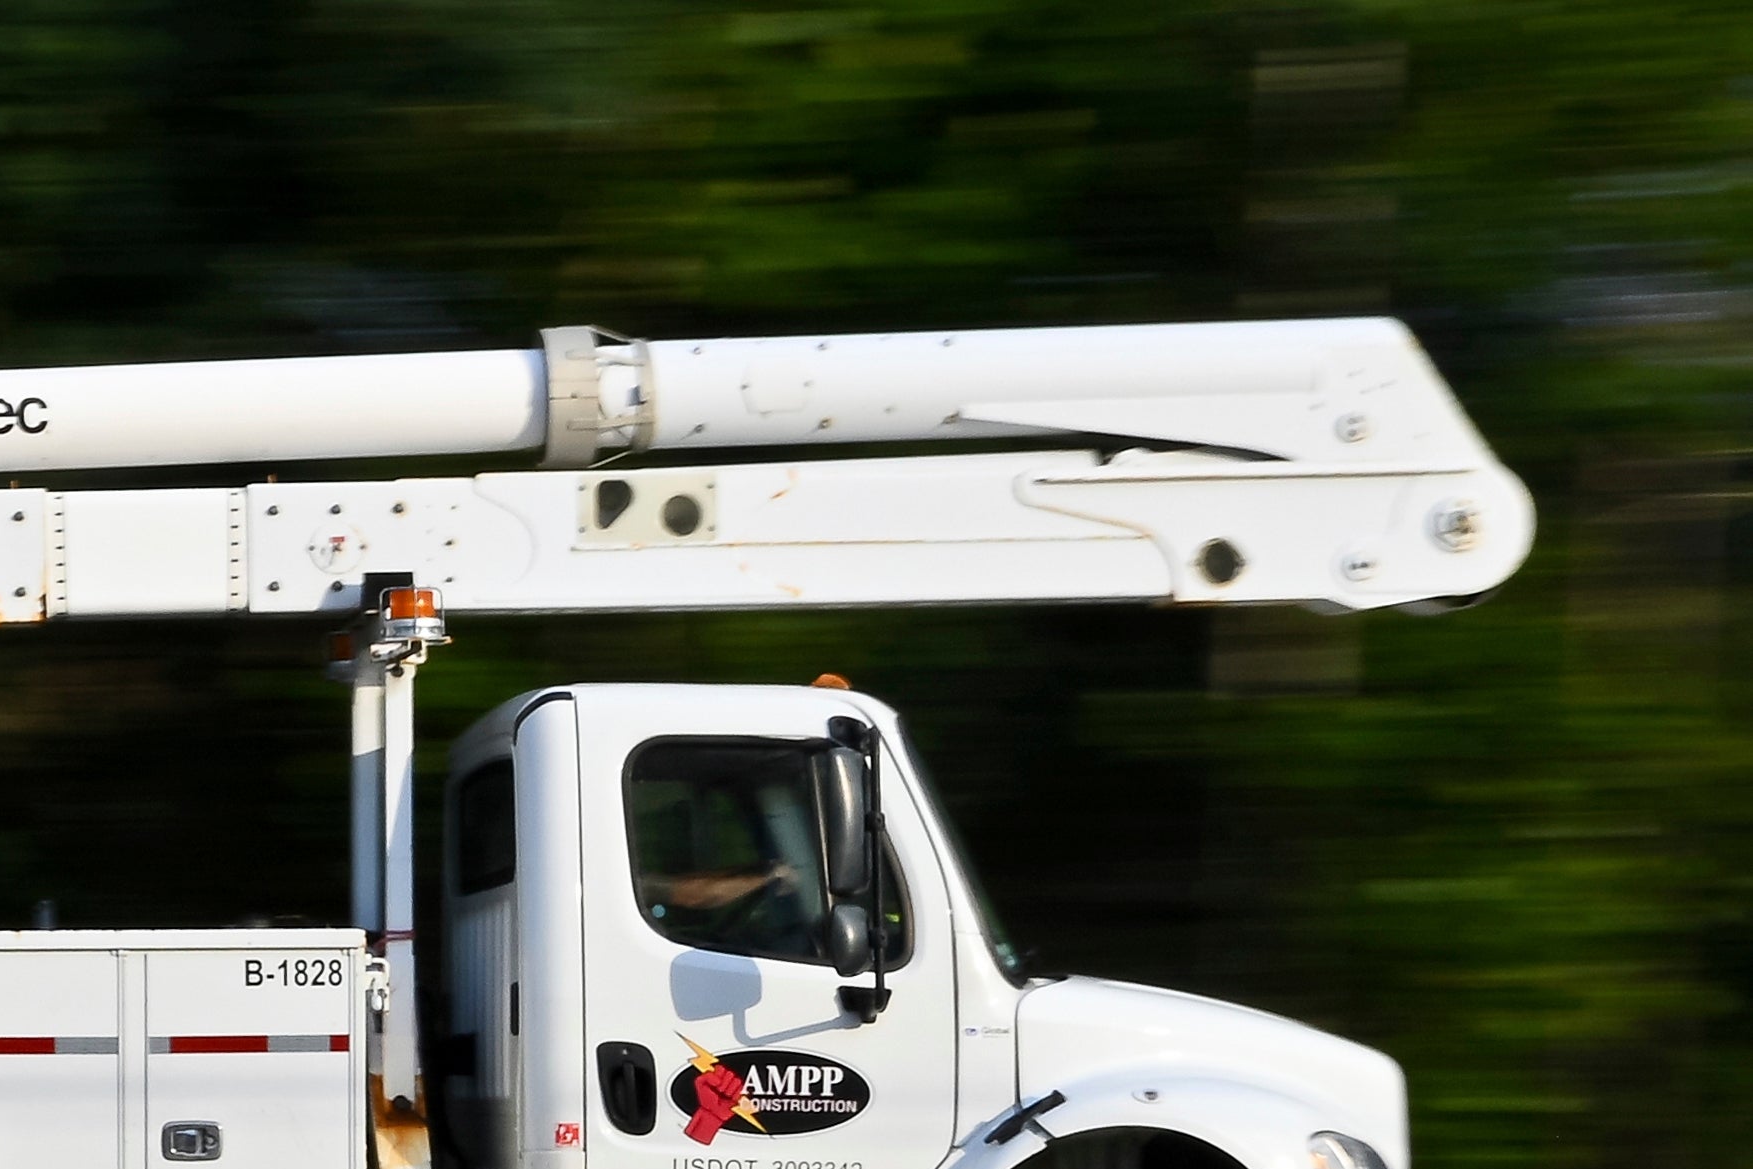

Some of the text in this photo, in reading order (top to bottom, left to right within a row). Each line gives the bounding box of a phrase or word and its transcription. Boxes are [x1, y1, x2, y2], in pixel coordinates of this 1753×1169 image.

[245, 959, 343, 986] B-1828
[741, 1064, 844, 1097] AMPP
[740, 1097, 857, 1113] ONSTRUCTION
